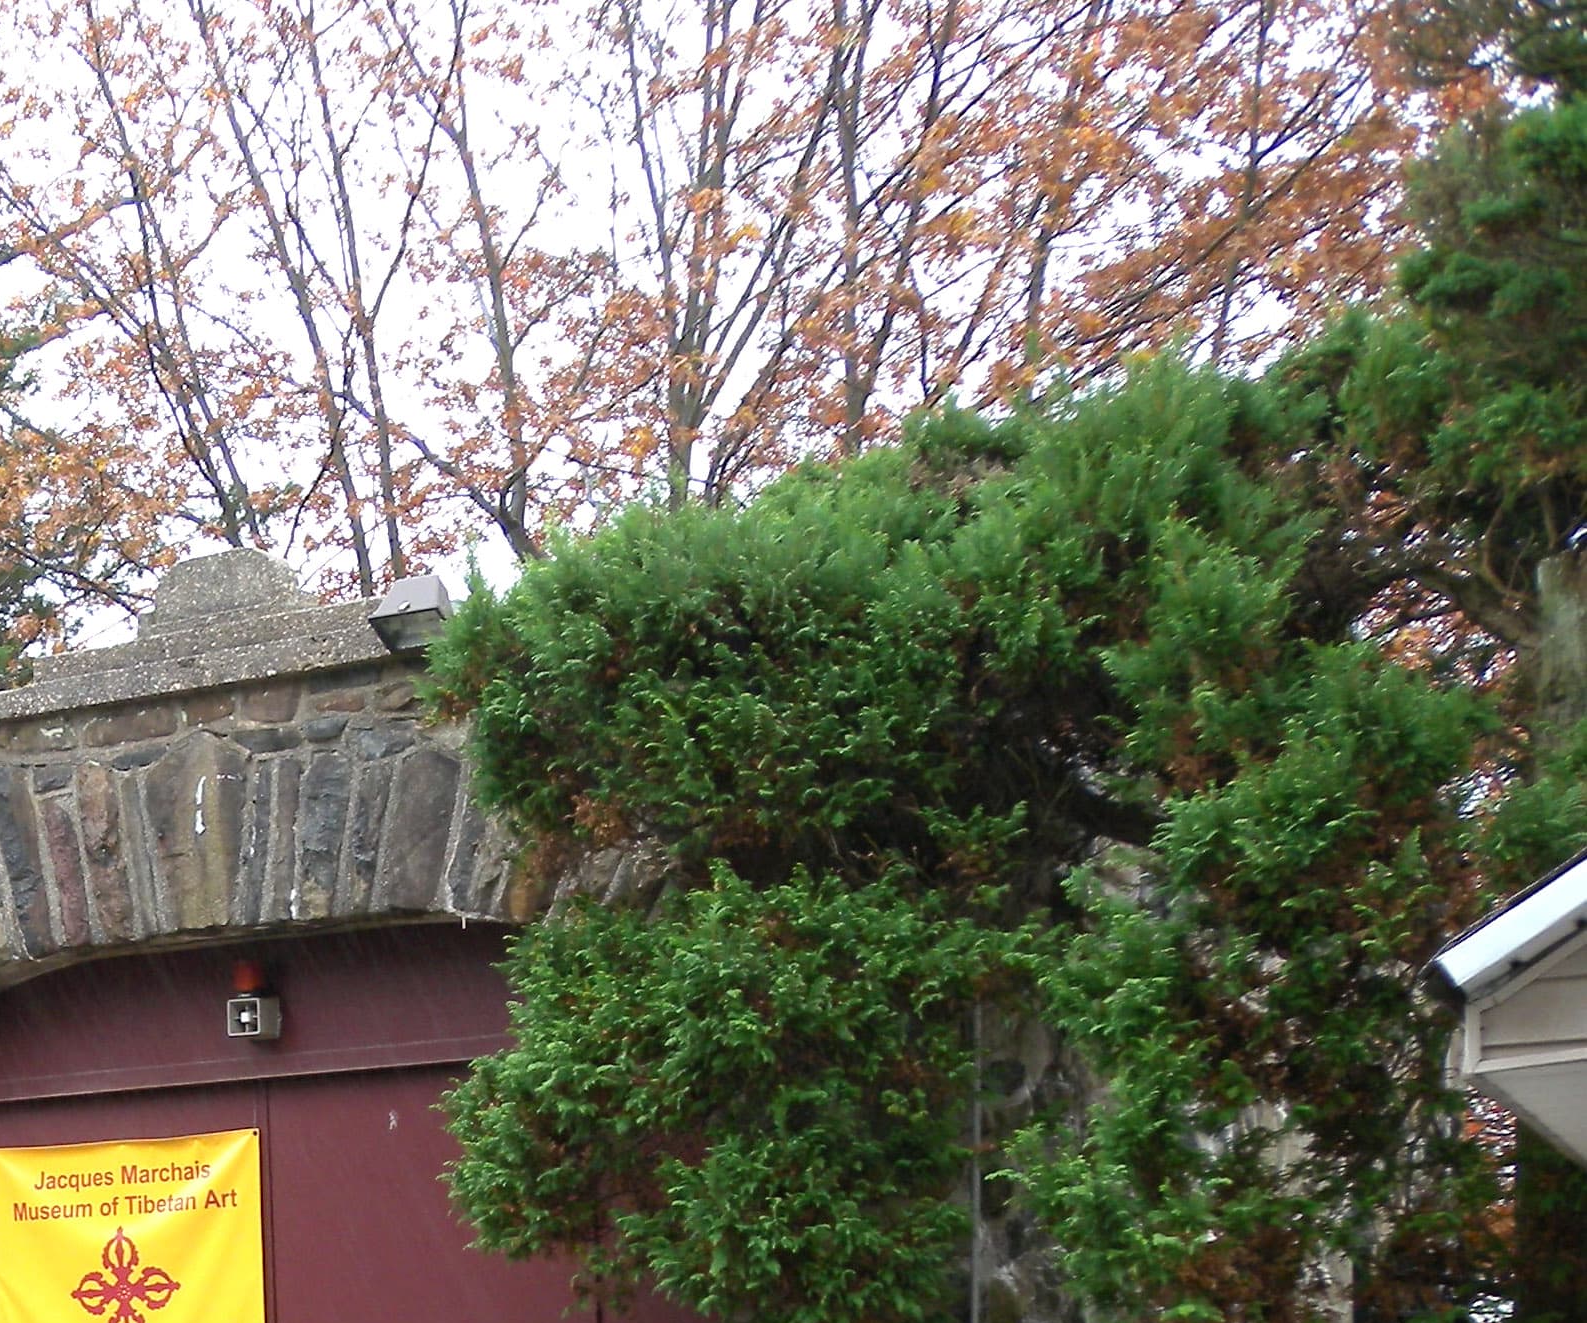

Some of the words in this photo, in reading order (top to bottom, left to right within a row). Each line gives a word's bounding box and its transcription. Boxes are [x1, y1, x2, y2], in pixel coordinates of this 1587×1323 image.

[34, 1171, 114, 1192] Jacques
[121, 1160, 211, 1184] Marchais
[13, 1202, 93, 1221] Museum
[99, 1196, 119, 1216] of
[124, 1194, 197, 1214] Tibetan
[204, 1188, 238, 1209] Art
